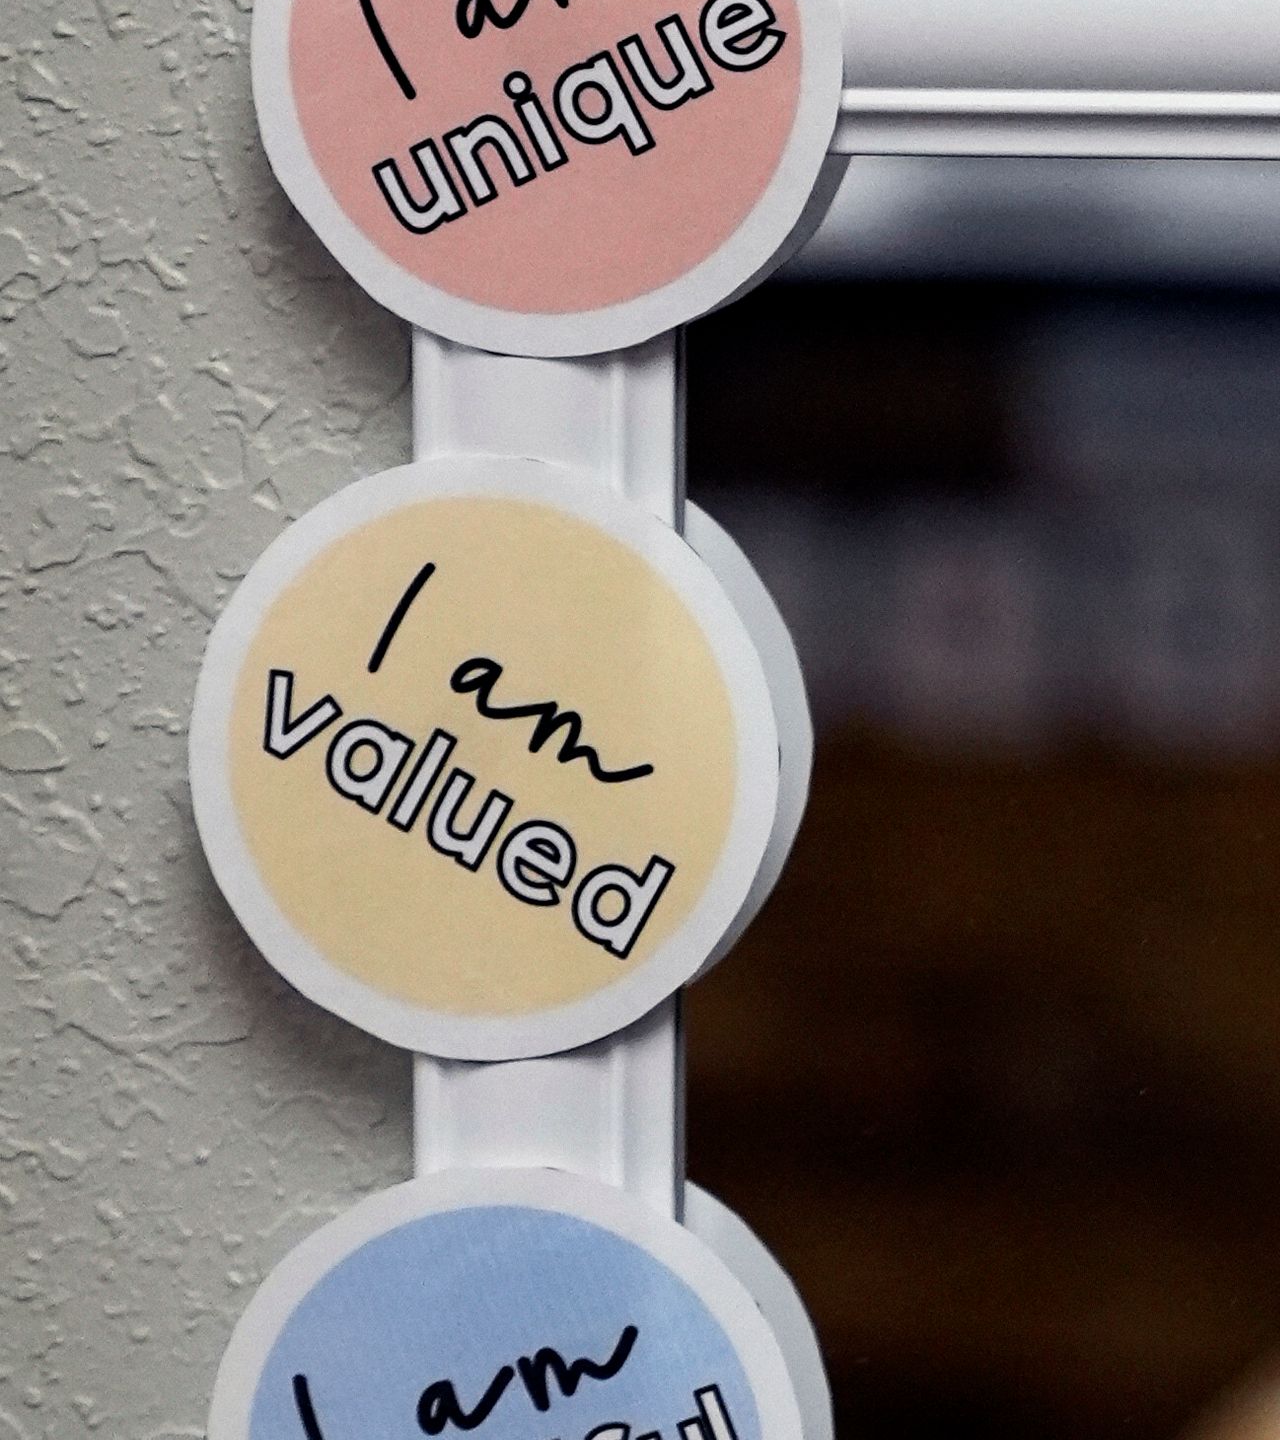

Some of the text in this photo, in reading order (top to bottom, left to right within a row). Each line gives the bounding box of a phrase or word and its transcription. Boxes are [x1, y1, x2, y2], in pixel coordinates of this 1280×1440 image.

[368, 563, 653, 783] I am
[263, 669, 675, 959] valued
[417, 1326, 638, 1435] am
